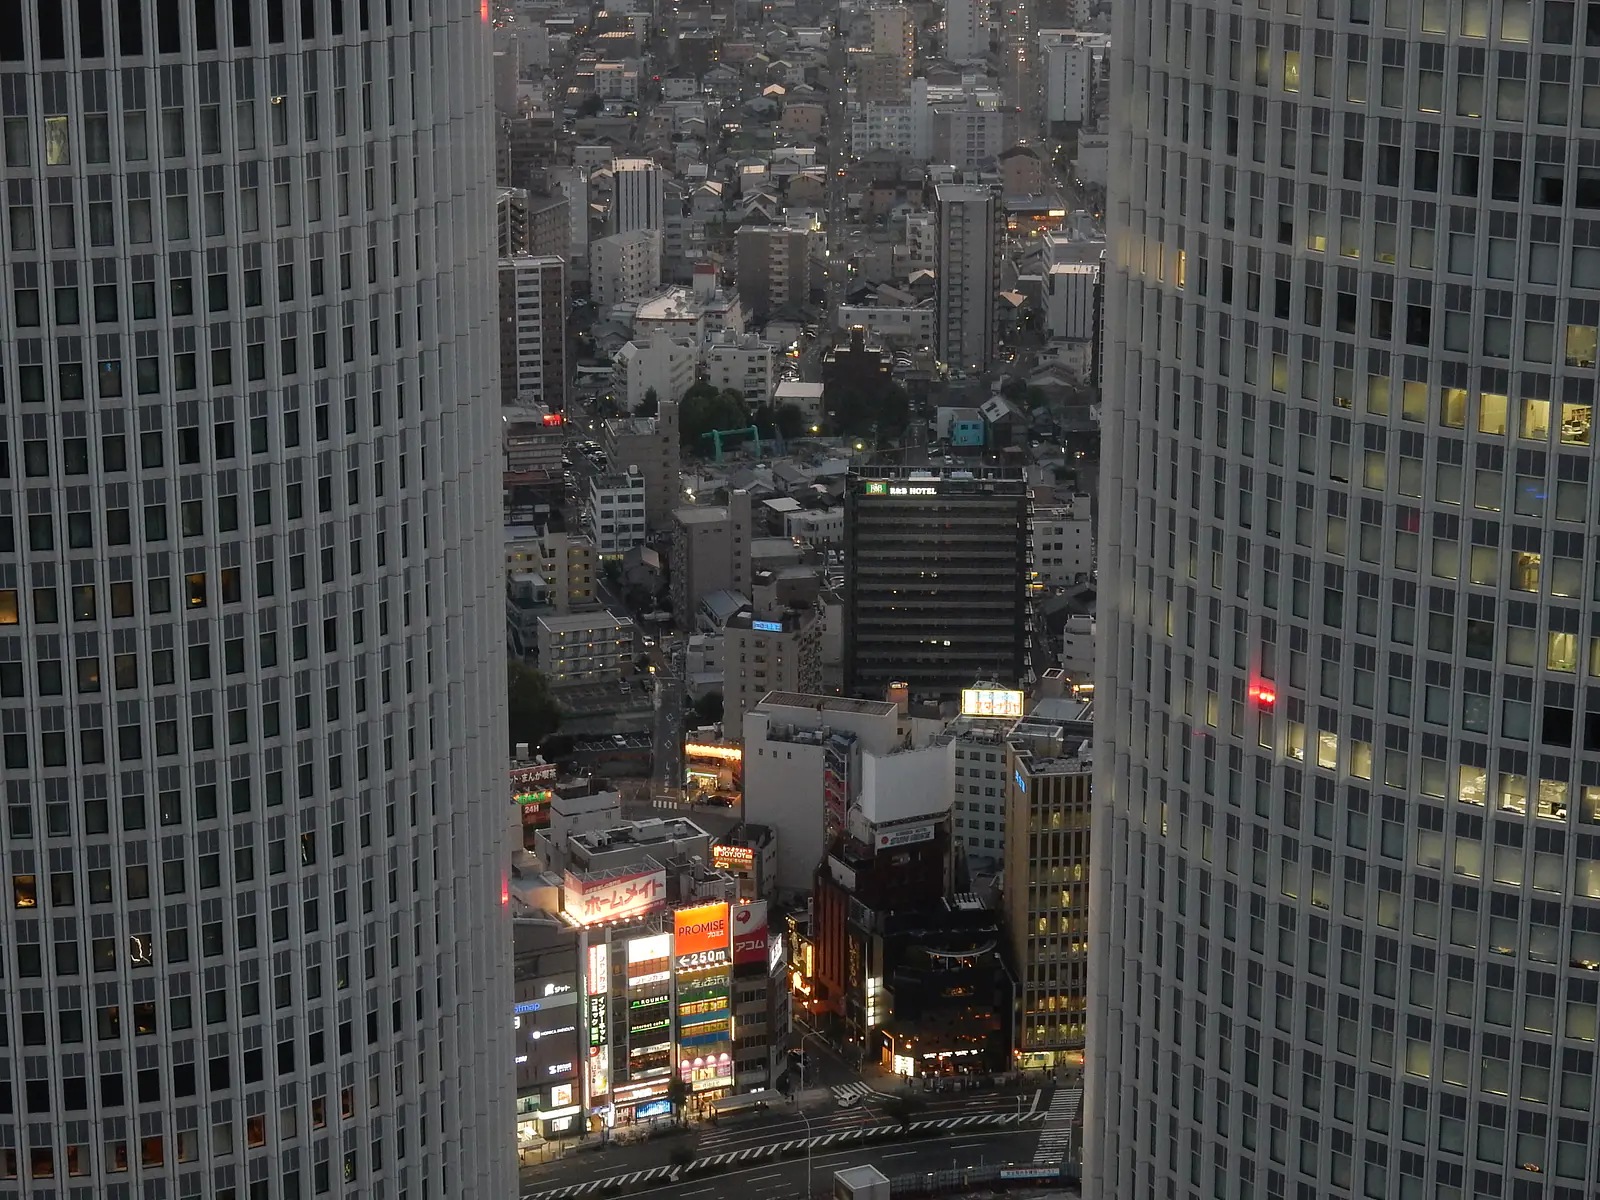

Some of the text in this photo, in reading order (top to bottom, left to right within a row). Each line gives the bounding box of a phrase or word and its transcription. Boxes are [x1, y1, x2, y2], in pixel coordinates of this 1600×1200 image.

[909, 487, 937, 495] HOTEL
[524, 804, 540, 814] 24H
[720, 850, 746, 859] JOYJOY
[584, 879, 664, 916] ホームメイト
[678, 919, 725, 937] PROMISE
[706, 930, 725, 938] プロミス
[735, 939, 765, 952] アコム
[691, 950, 726, 965] 250m
[591, 998, 599, 1027] コミック
[598, 996, 606, 1043] インターネット
